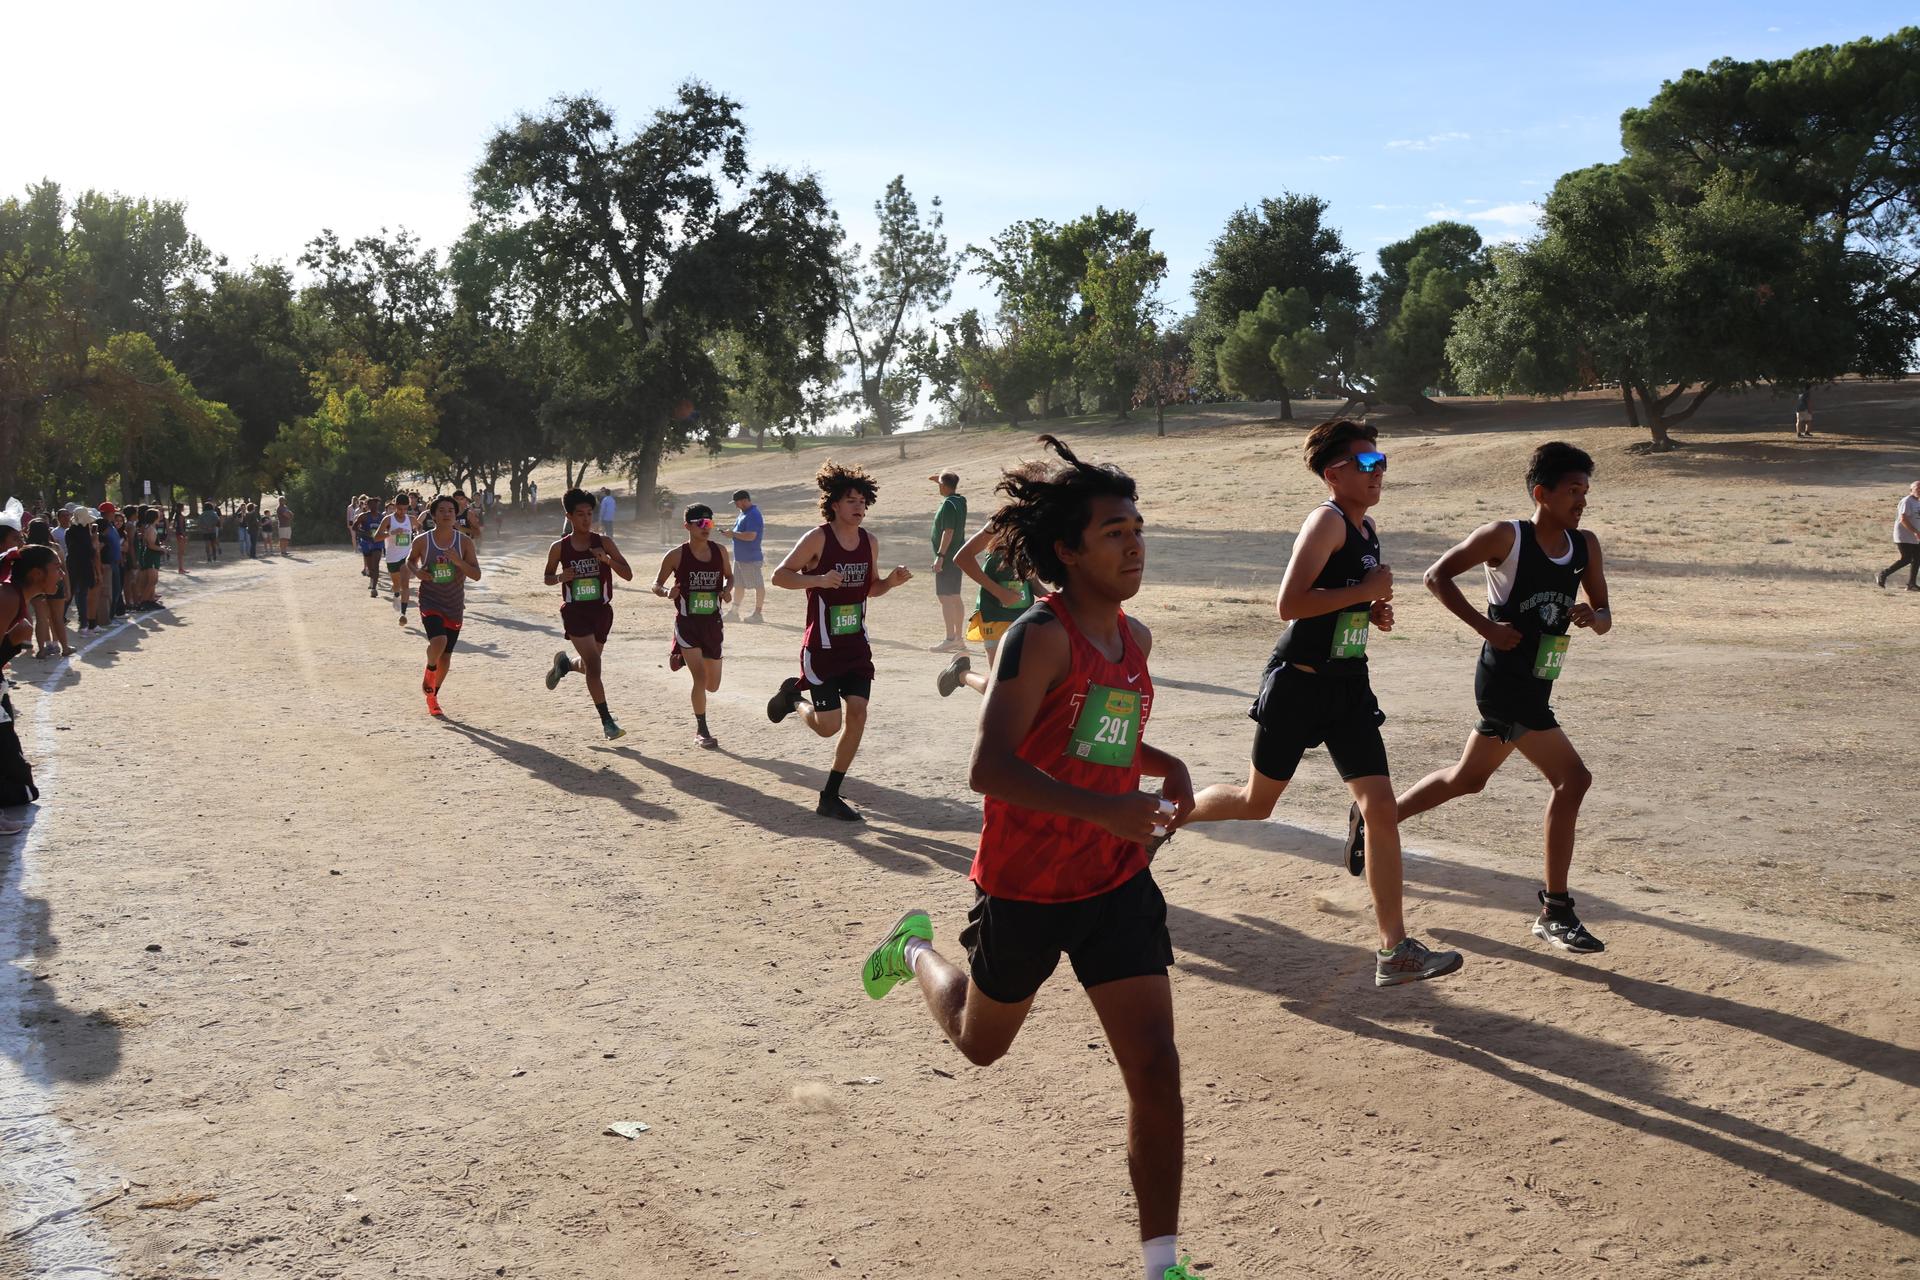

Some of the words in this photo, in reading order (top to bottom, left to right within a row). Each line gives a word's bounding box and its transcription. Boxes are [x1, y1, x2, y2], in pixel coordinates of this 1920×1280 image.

[434, 569, 452, 578] 1515
[576, 585, 596, 595] 1506
[836, 614, 857, 627] 1505
[1094, 715, 1130, 746] 291
